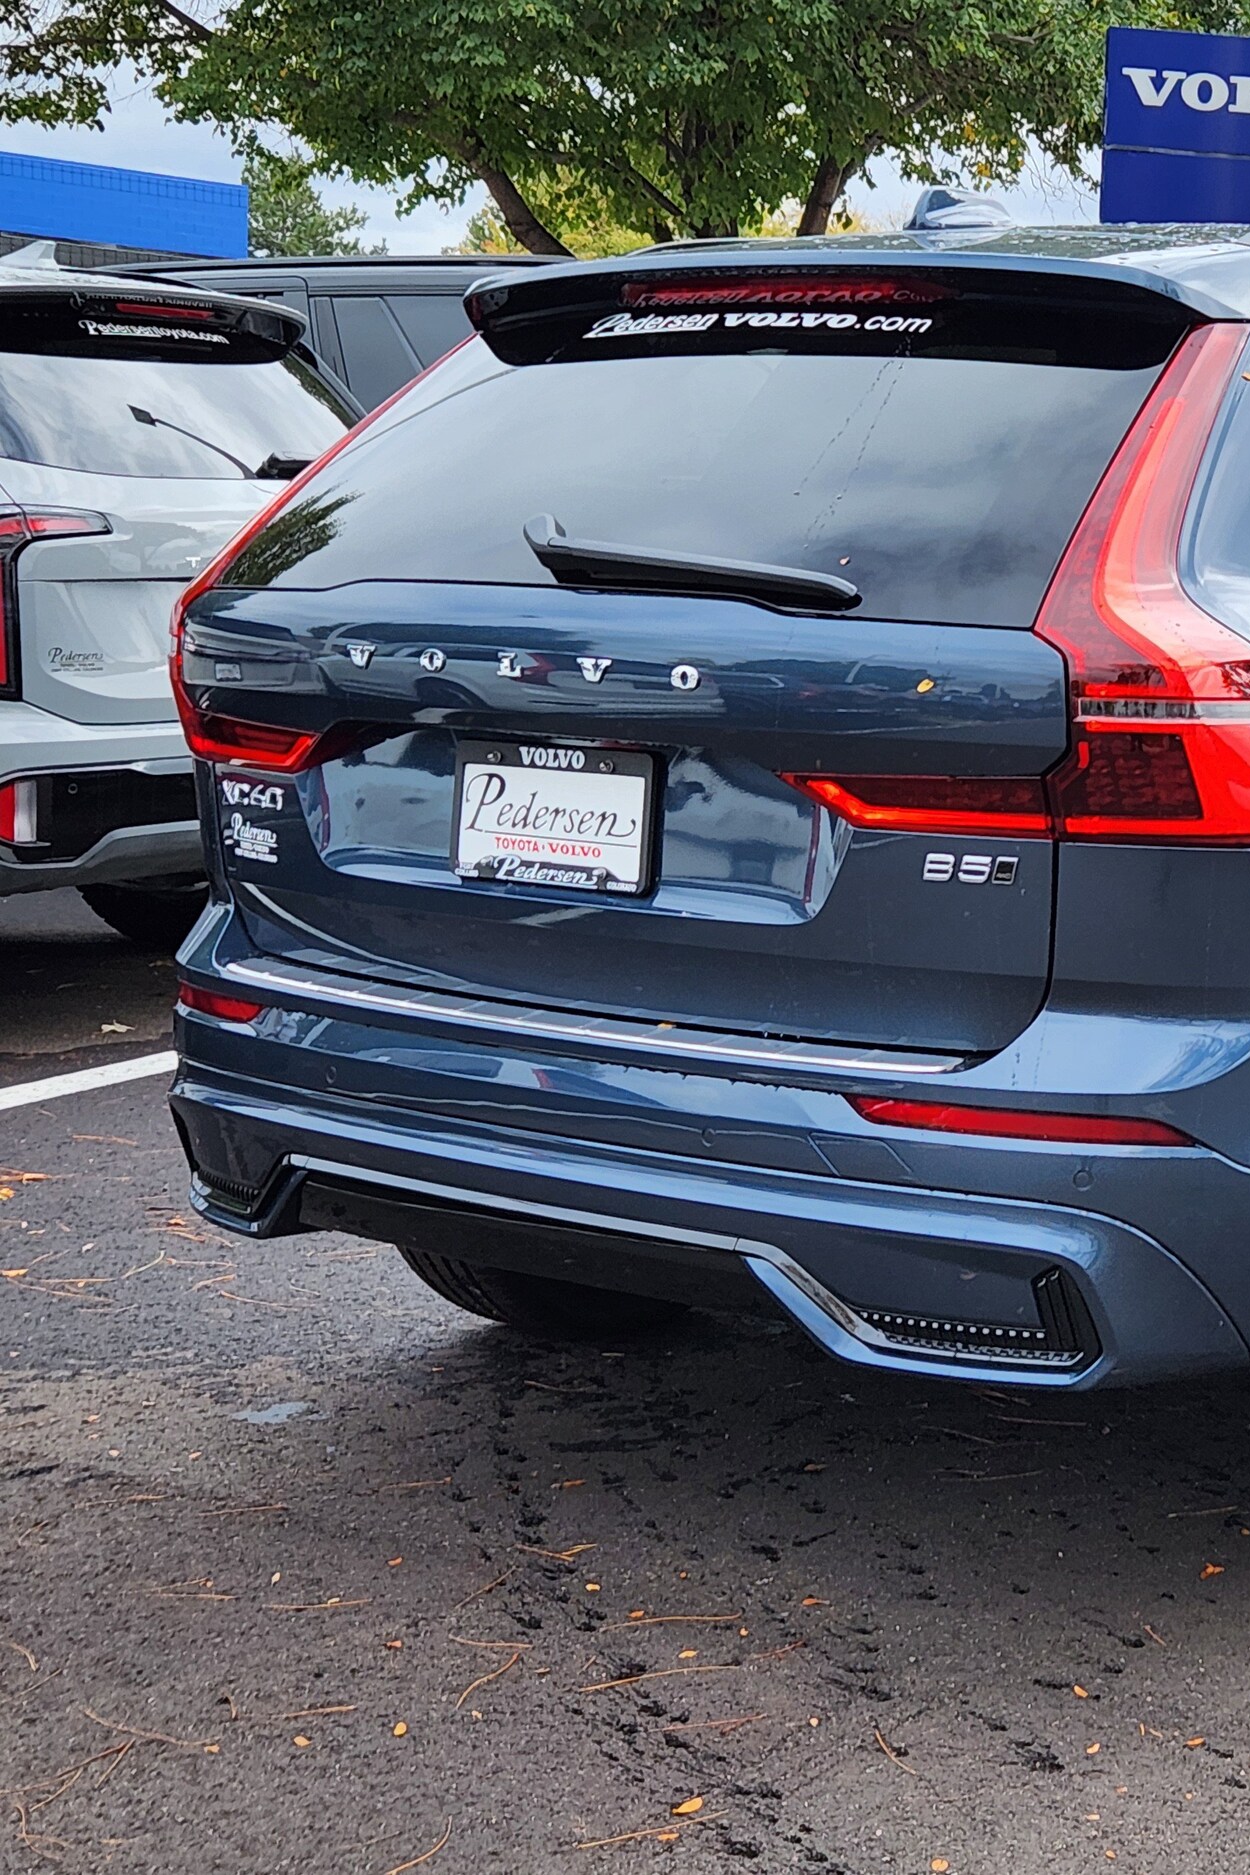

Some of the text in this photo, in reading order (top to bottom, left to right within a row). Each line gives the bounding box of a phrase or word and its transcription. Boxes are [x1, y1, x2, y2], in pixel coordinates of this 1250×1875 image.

[582, 312, 720, 339] Pedersen
[47, 646, 105, 664] Pedersen
[346, 644, 700, 691] VOLVO
[518, 746, 586, 770] VOLVO
[464, 772, 637, 838] Pedersen
[231, 812, 278, 848] Pedersen
[494, 836, 602, 859] TOYOTA VOLVO
[493, 855, 599, 889] Pedersen
[922, 852, 993, 884] B5
